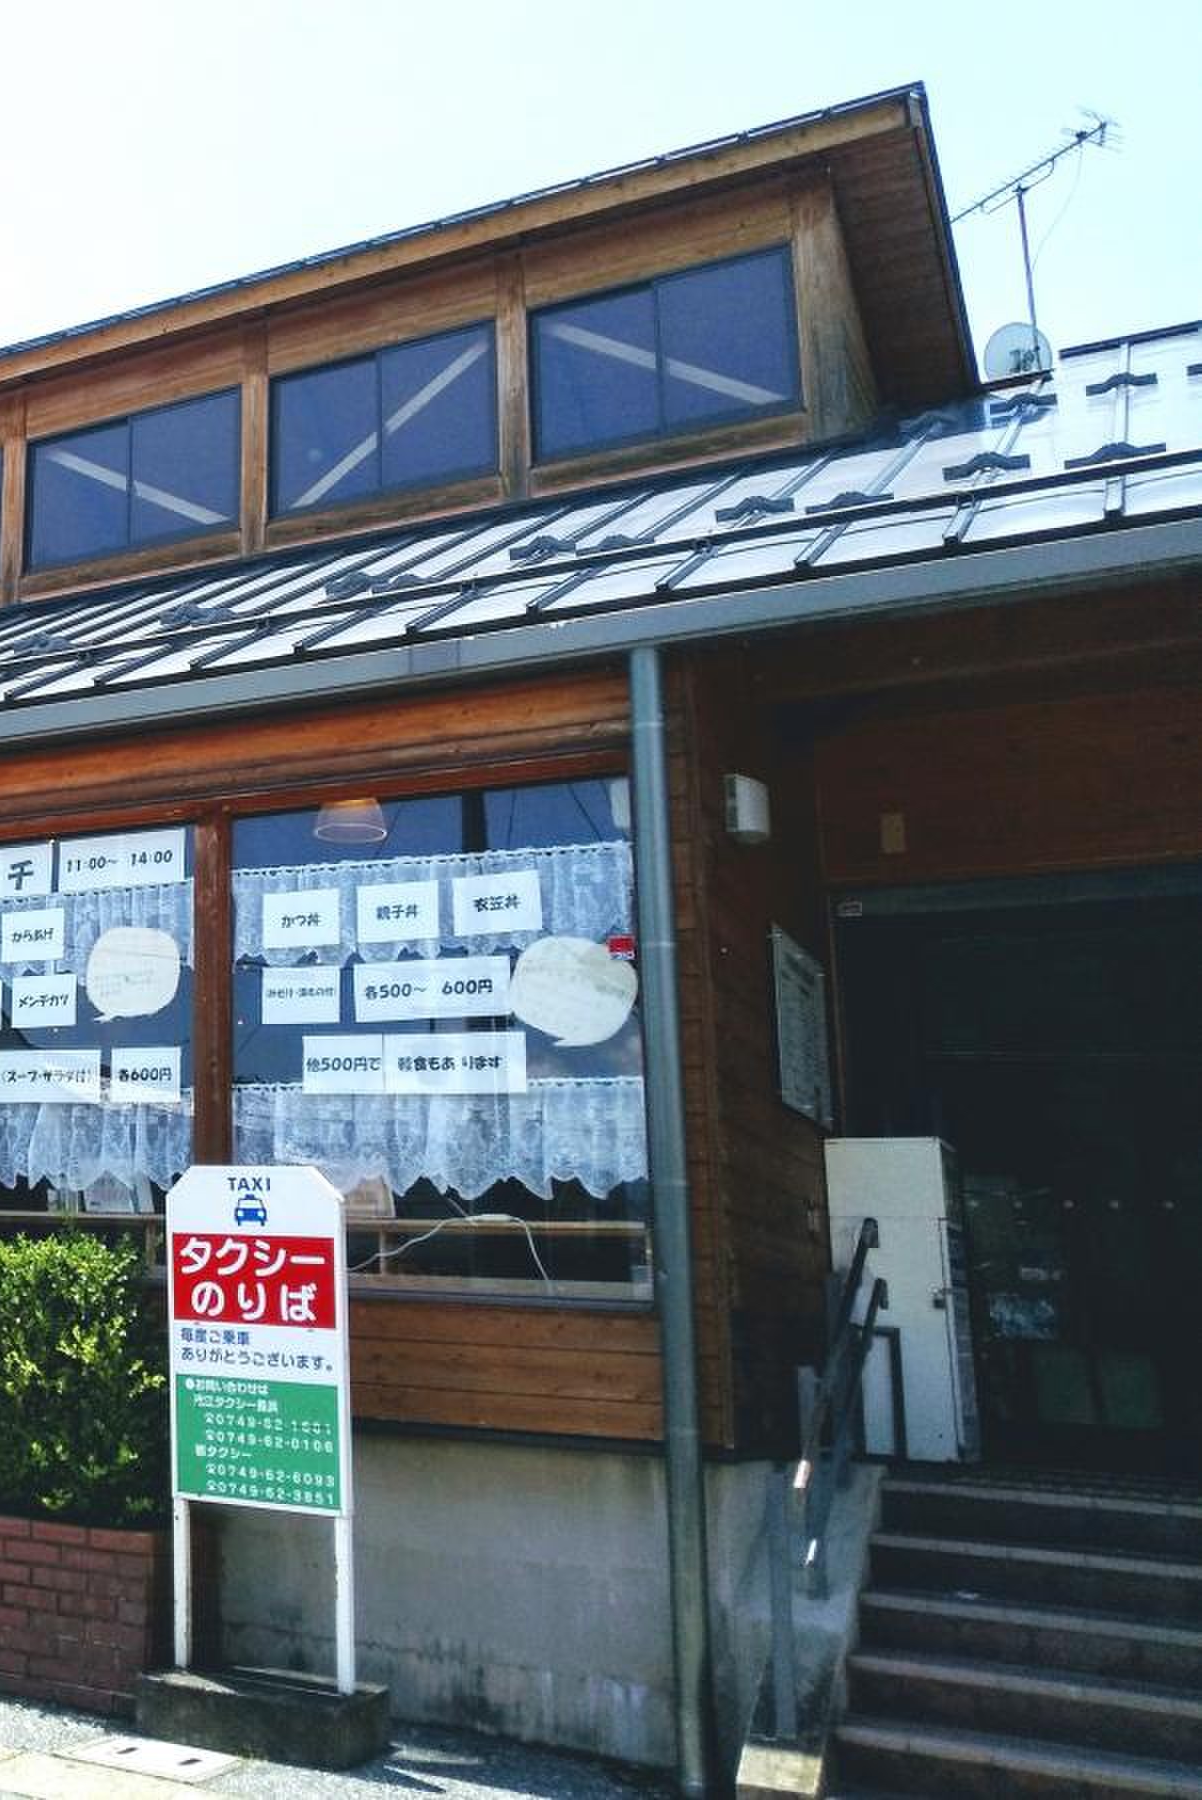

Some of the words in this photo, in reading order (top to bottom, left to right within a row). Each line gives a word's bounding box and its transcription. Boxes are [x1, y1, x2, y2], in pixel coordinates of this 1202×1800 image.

[472, 893, 522, 912] 衣笠丼
[280, 913, 322, 929] かつ丼
[375, 903, 419, 921] 親子丼
[440, 977, 494, 996] 600円
[17, 993, 70, 1009] メンチカツ
[305, 1055, 382, 1073] 他500円で
[118, 1067, 173, 1083] 各600円
[227, 1177, 272, 1191] TAXI
[180, 1237, 326, 1277] タクシー
[191, 1281, 318, 1322] のりば
[181, 1346, 334, 1372] ありがとうございます。
[195, 1444, 253, 1460] タクシー
